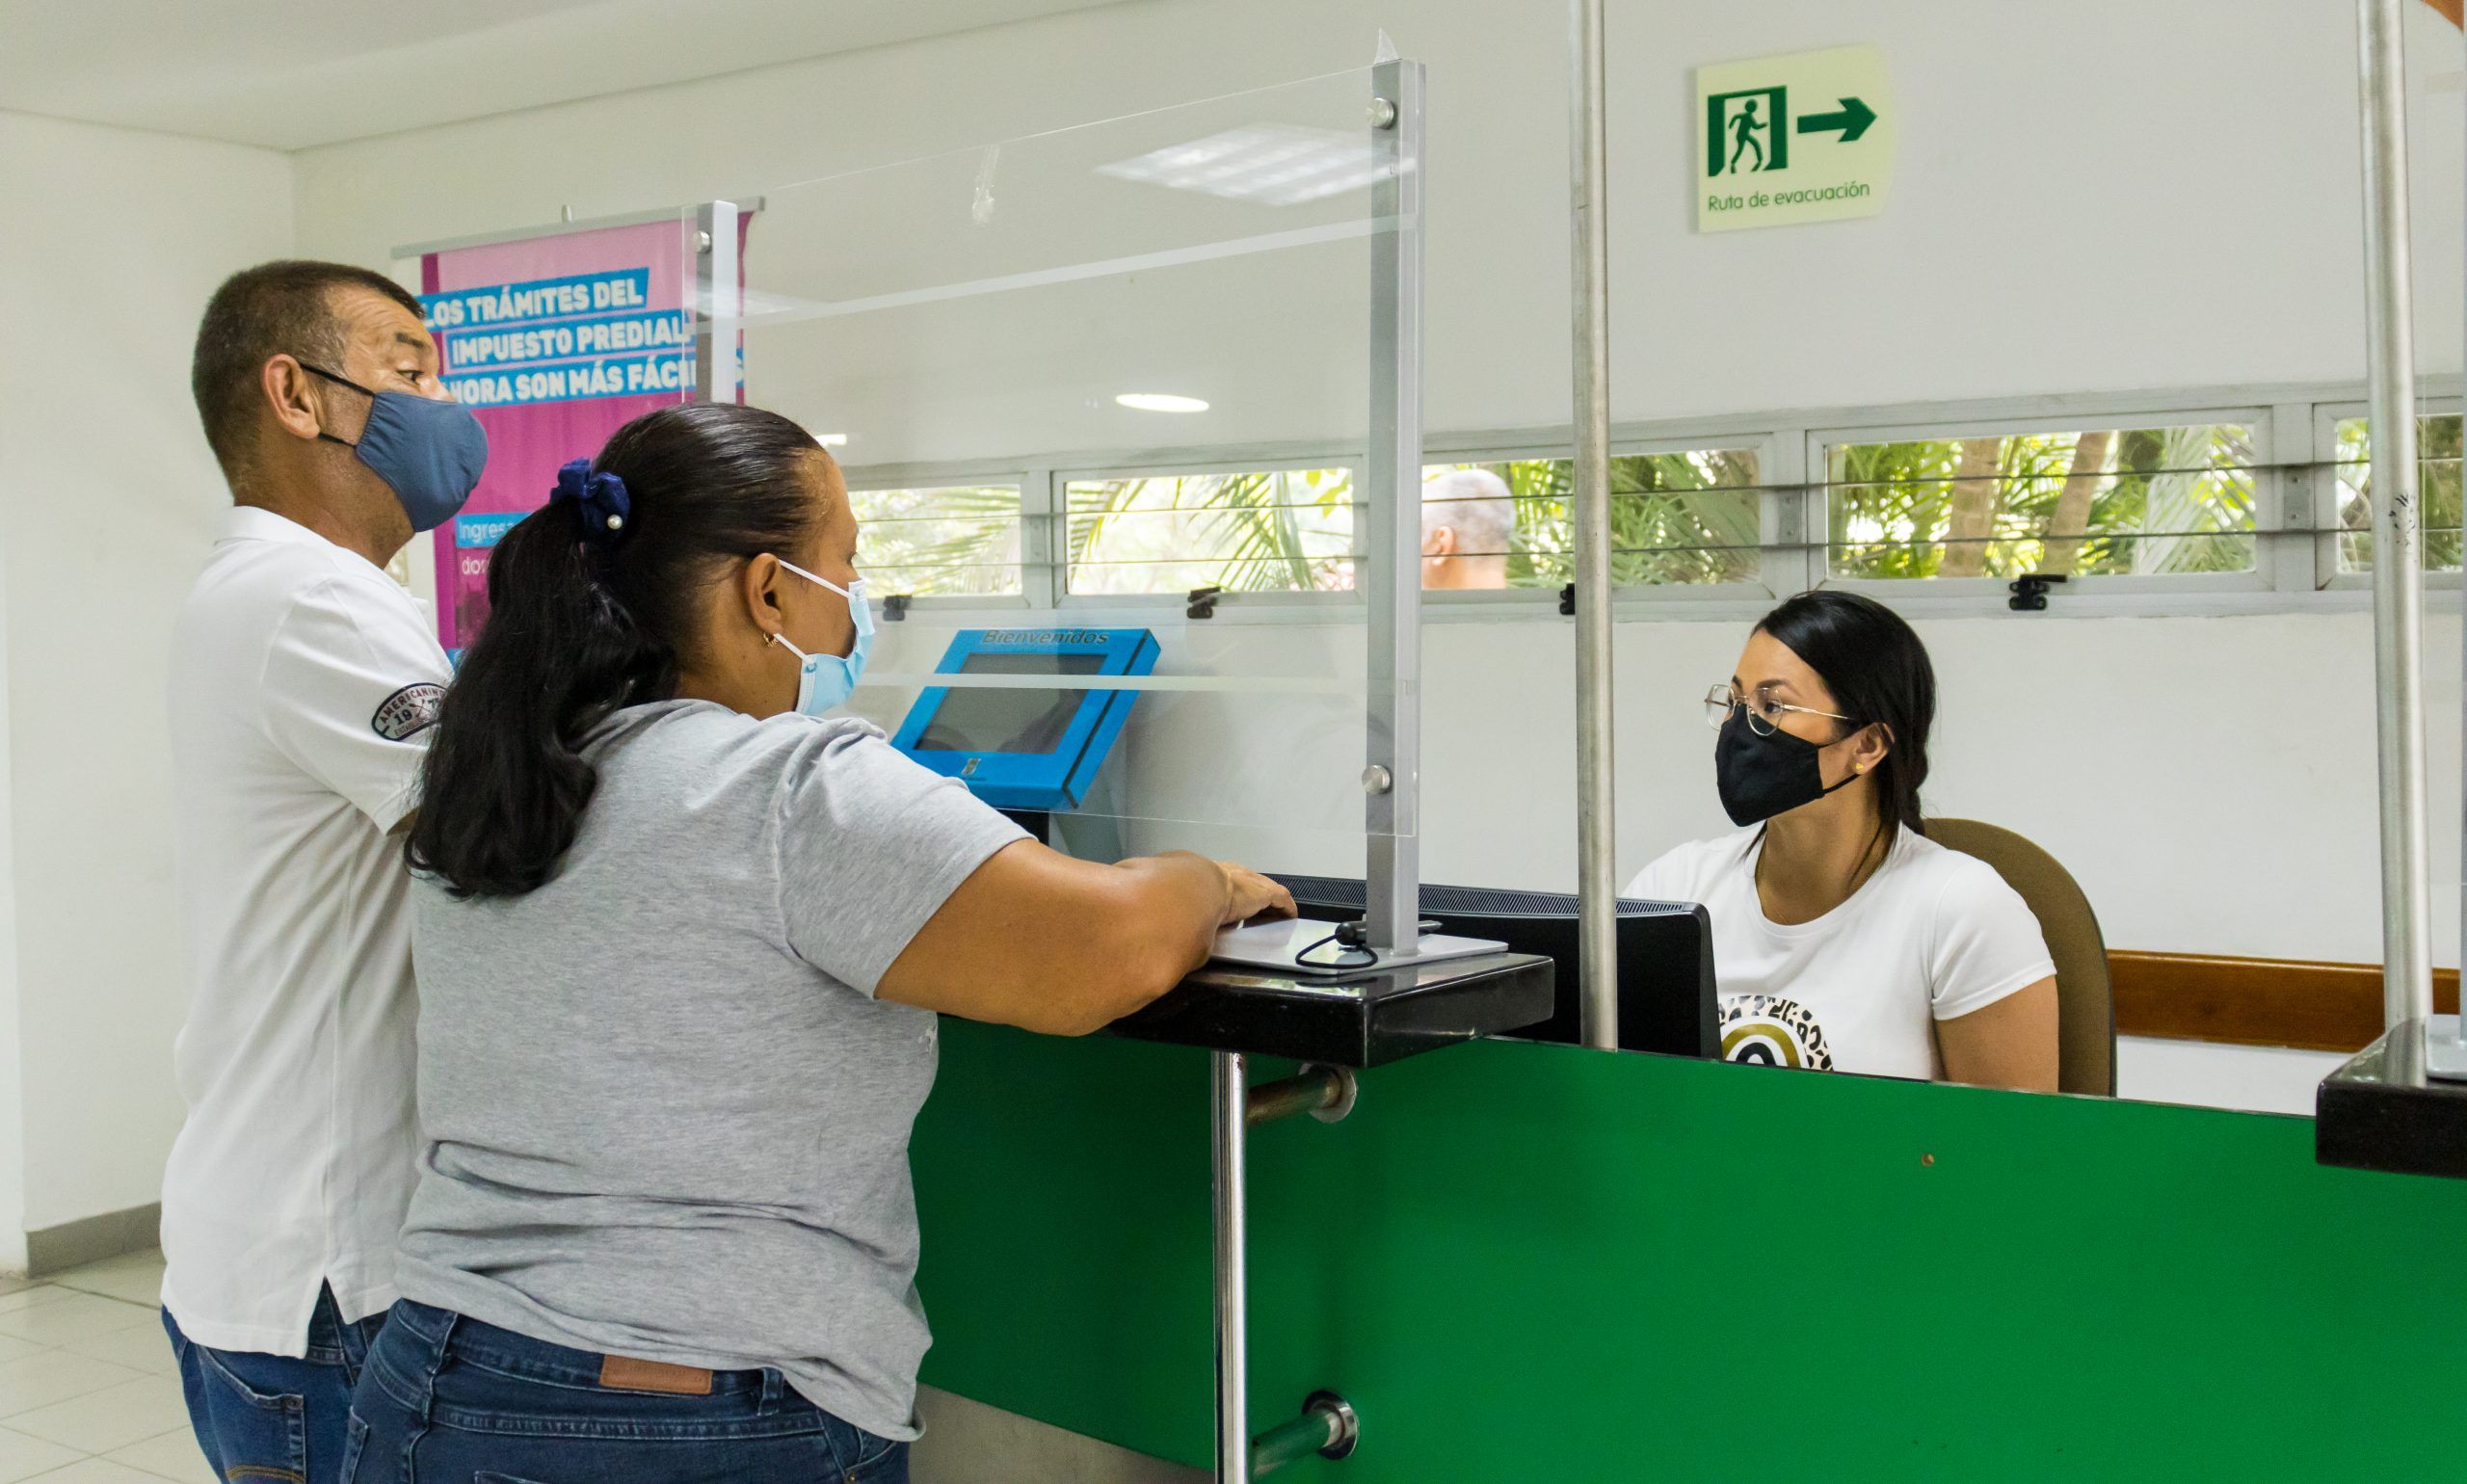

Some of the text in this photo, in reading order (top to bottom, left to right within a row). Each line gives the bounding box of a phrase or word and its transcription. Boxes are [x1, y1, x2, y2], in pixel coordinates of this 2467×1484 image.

[1708, 180, 1870, 211] Ruta de evacuación
[466, 283, 590, 323] TRÁMITES
[593, 278, 644, 309] DEL
[452, 316, 691, 365] IMPUESTO PREDIAL
[445, 376, 514, 405] HORA
[516, 370, 567, 401] SON
[569, 359, 623, 396] MÁS
[982, 628, 1109, 645] Bienvenidos
[393, 709, 412, 725] 19
